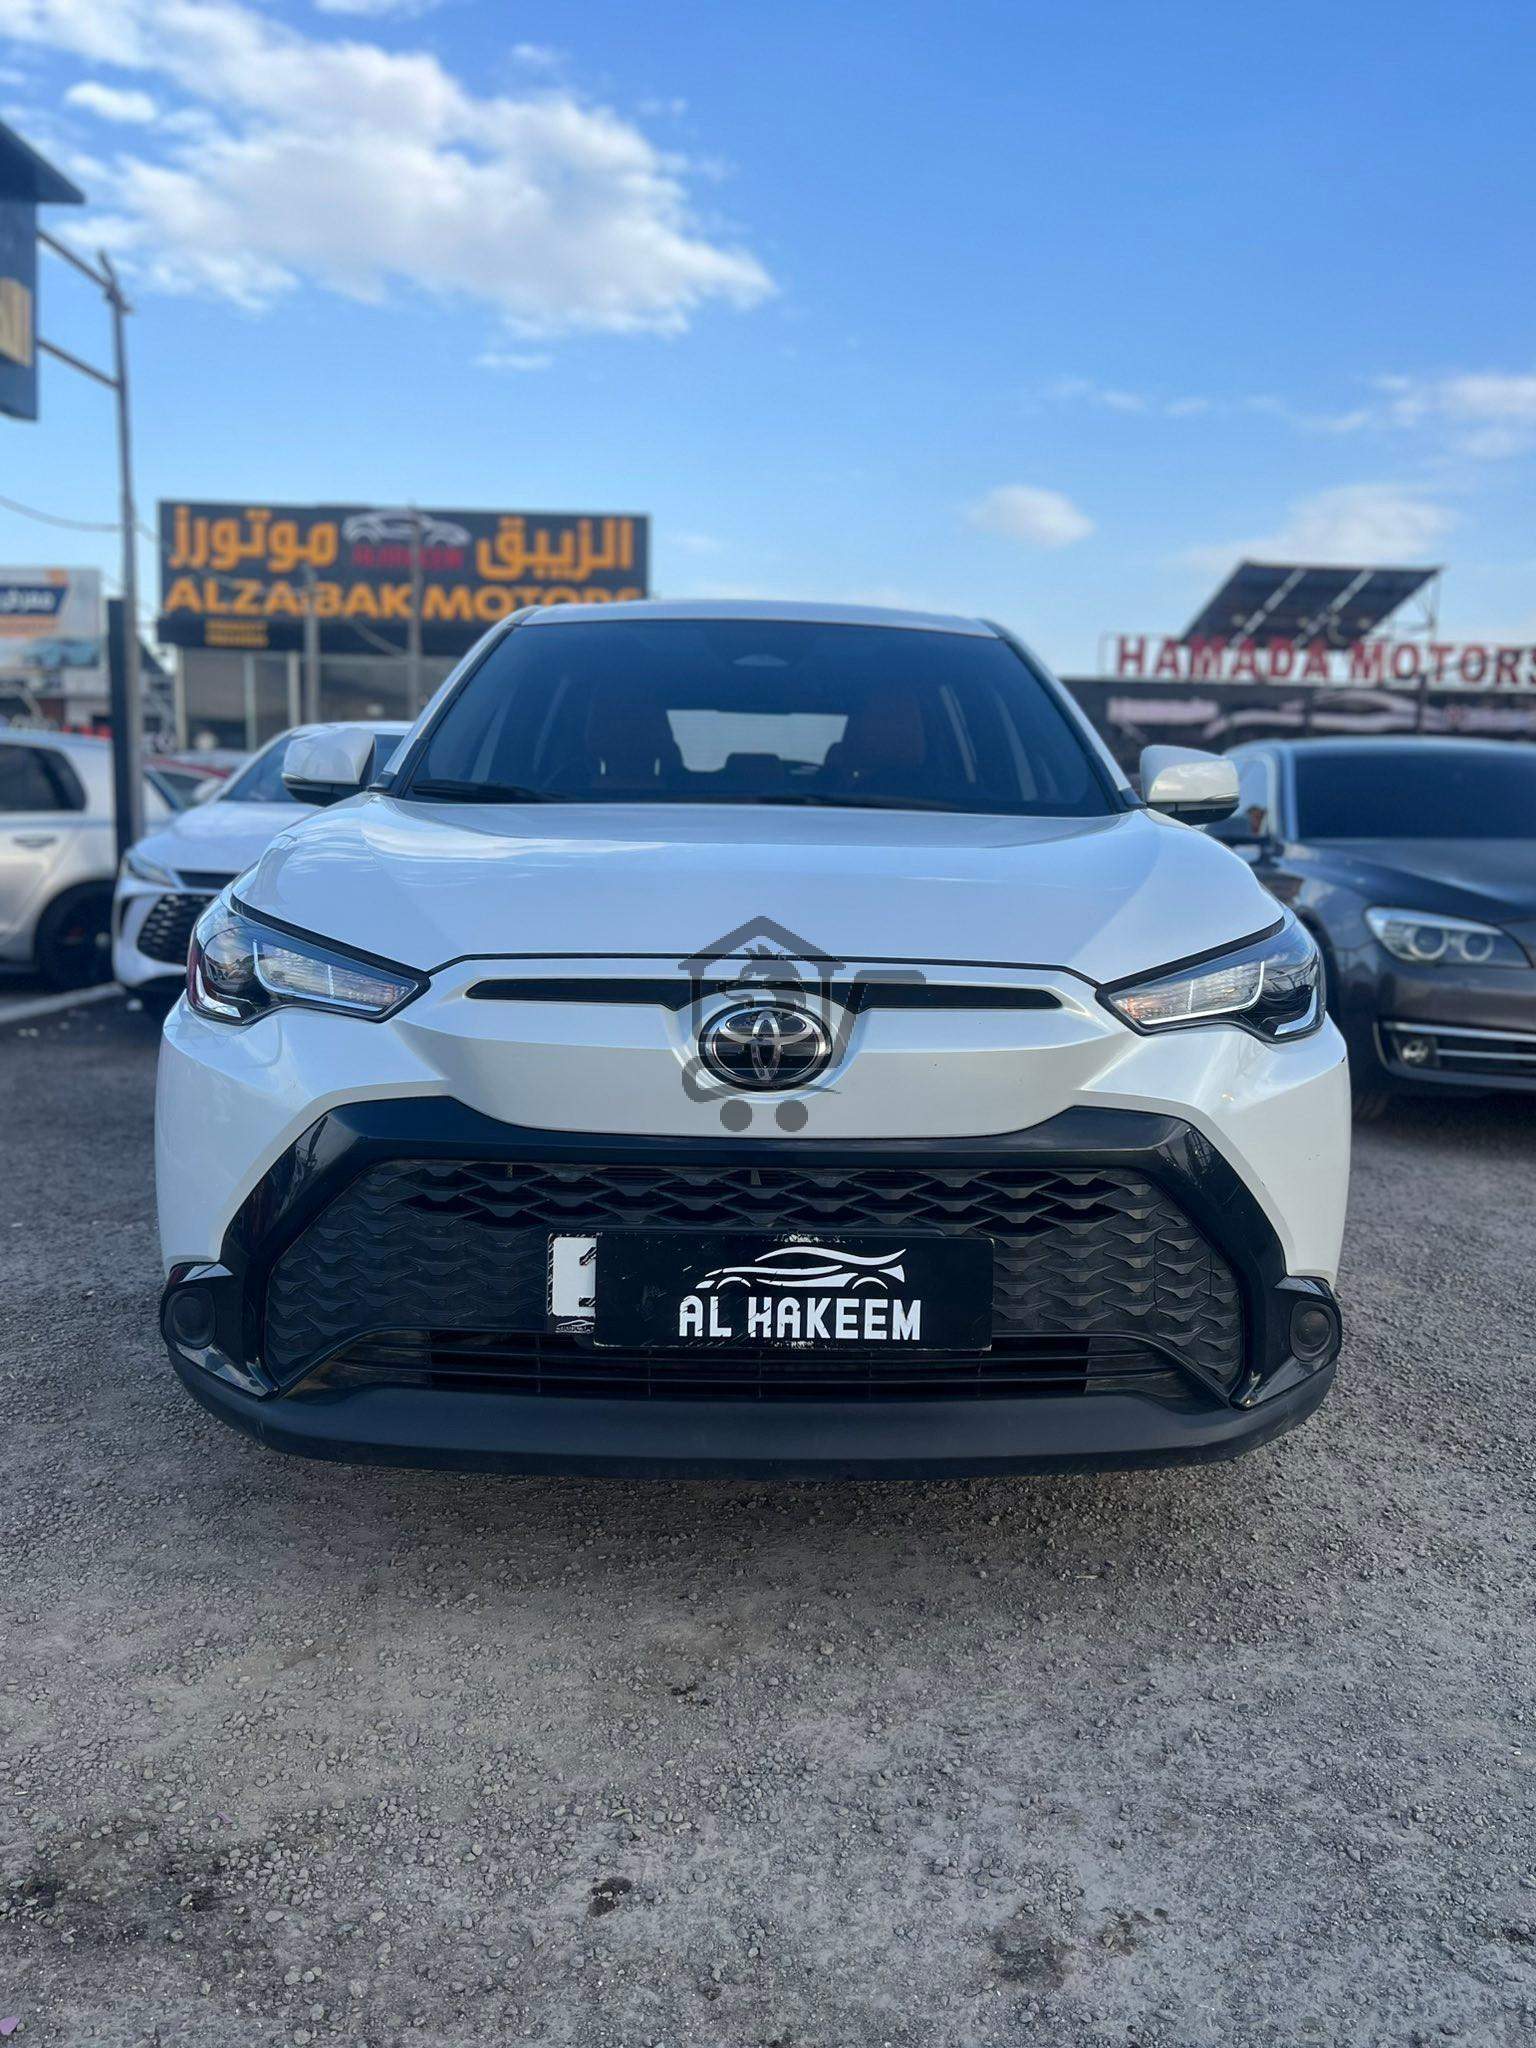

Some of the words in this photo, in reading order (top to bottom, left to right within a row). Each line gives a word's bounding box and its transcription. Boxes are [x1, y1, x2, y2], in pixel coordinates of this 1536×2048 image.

[169, 506, 338, 573] موتورز
[165, 577, 414, 622] ALZABAK
[1117, 634, 1330, 682] HAMADA
[679, 1295, 732, 1338] AL
[748, 1297, 921, 1341] HAKEEM
